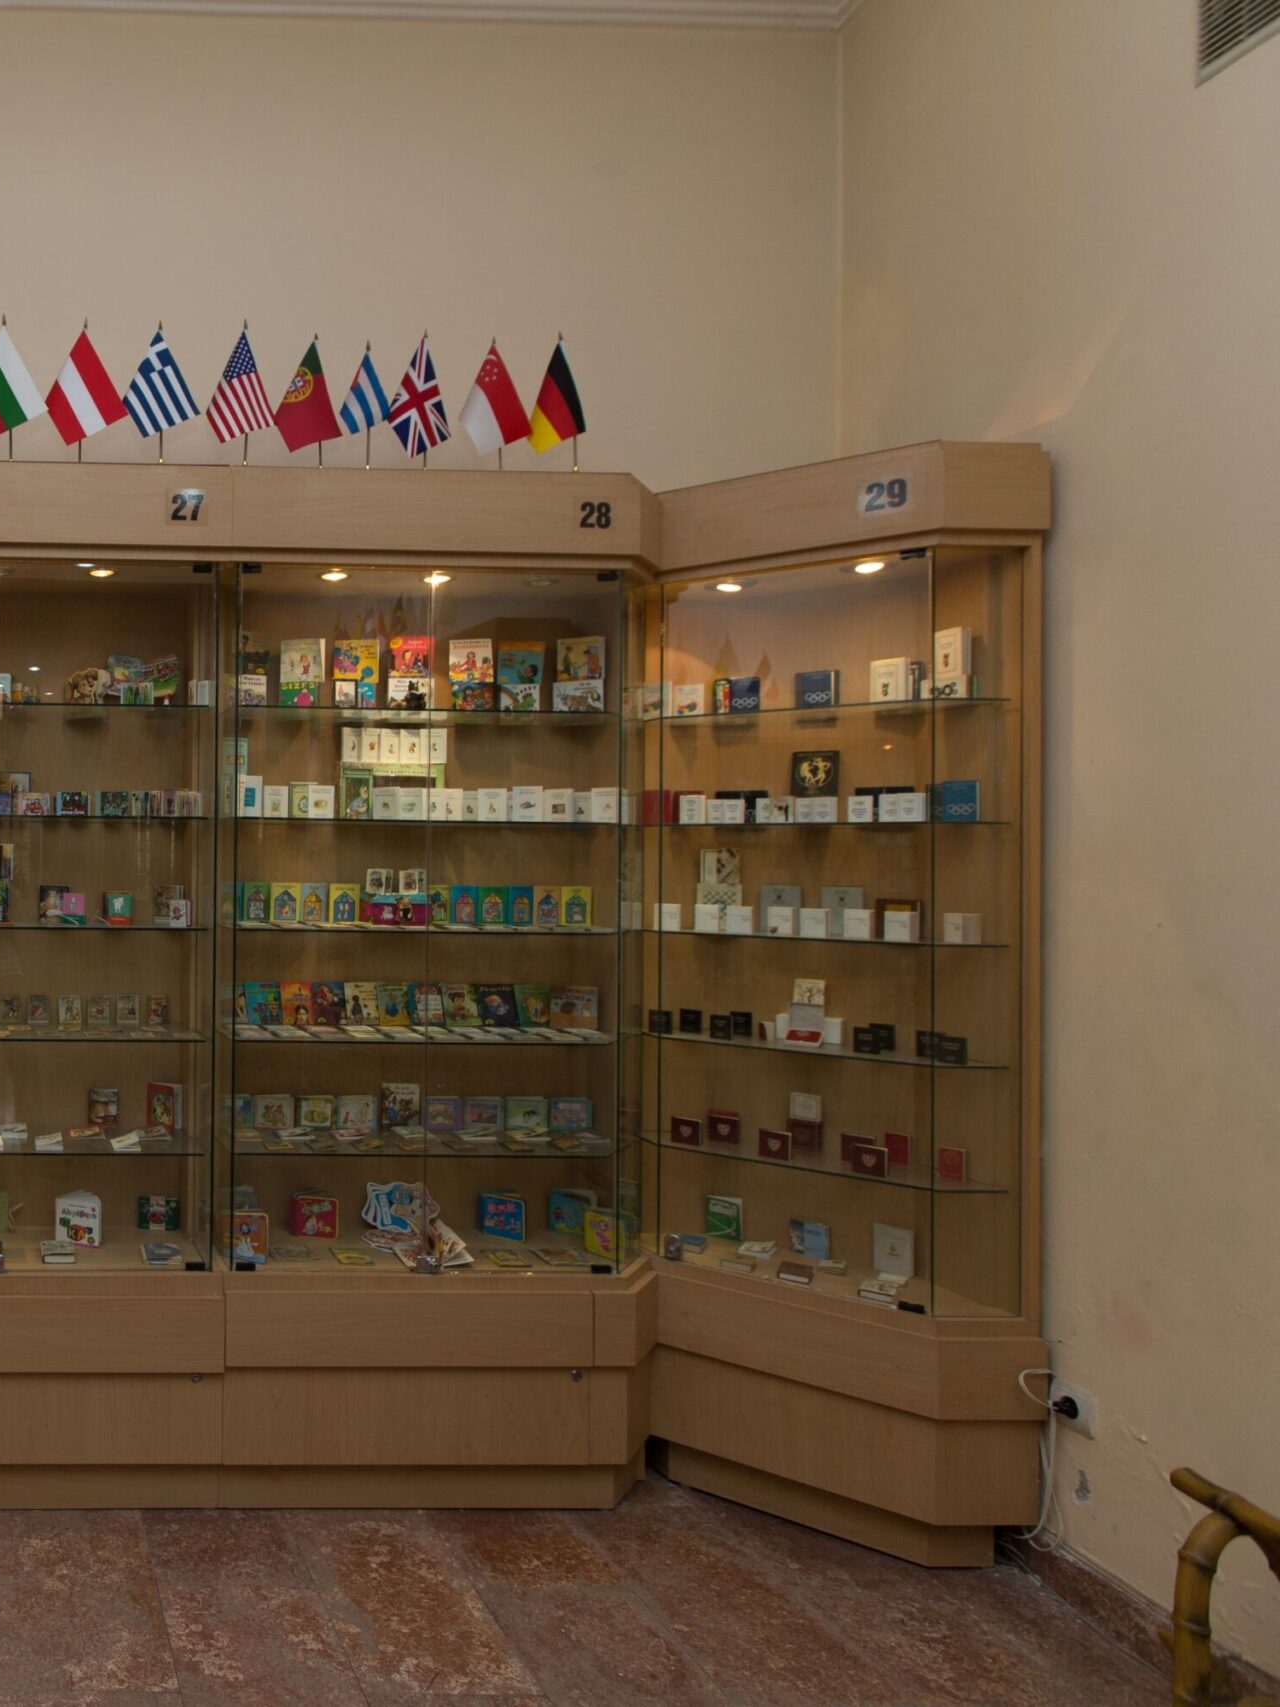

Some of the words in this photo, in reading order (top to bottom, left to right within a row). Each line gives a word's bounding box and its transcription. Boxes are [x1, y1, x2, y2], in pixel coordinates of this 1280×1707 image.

[171, 494, 204, 521] 27
[864, 478, 907, 513] 29
[580, 501, 613, 529] 28
